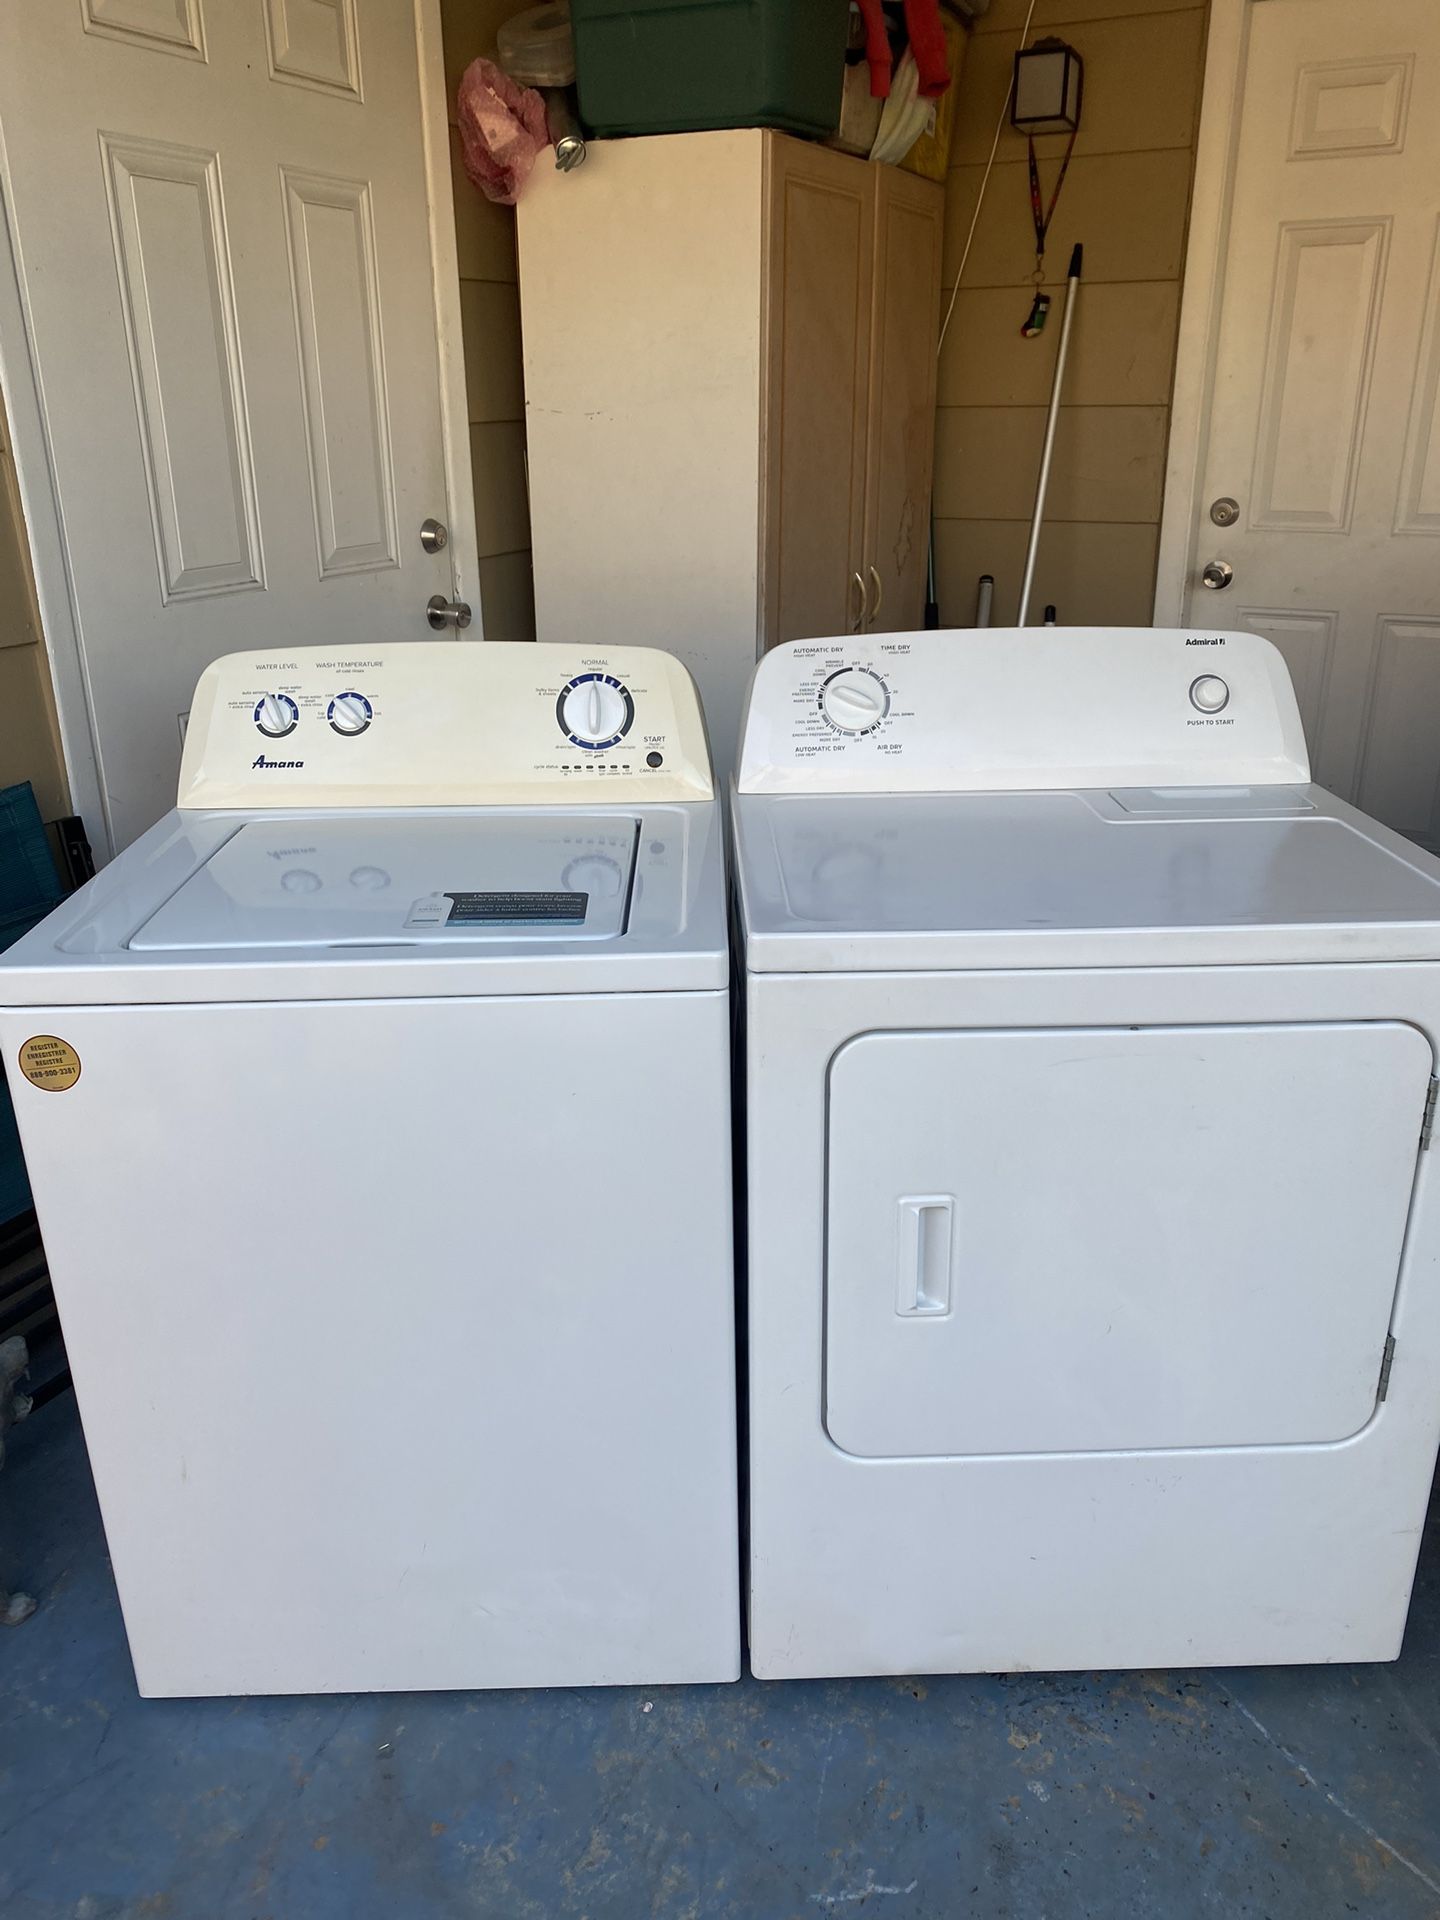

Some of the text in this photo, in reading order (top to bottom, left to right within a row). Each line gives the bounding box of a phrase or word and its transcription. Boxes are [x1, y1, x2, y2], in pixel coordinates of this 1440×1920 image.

[1185, 638, 1219, 646] Admiral
[252, 754, 304, 769] Amana
[30, 1042, 58, 1051] REGISTER
[27, 1049, 67, 1059] ENREGISTRER
[35, 1057, 63, 1066] REGISTRE
